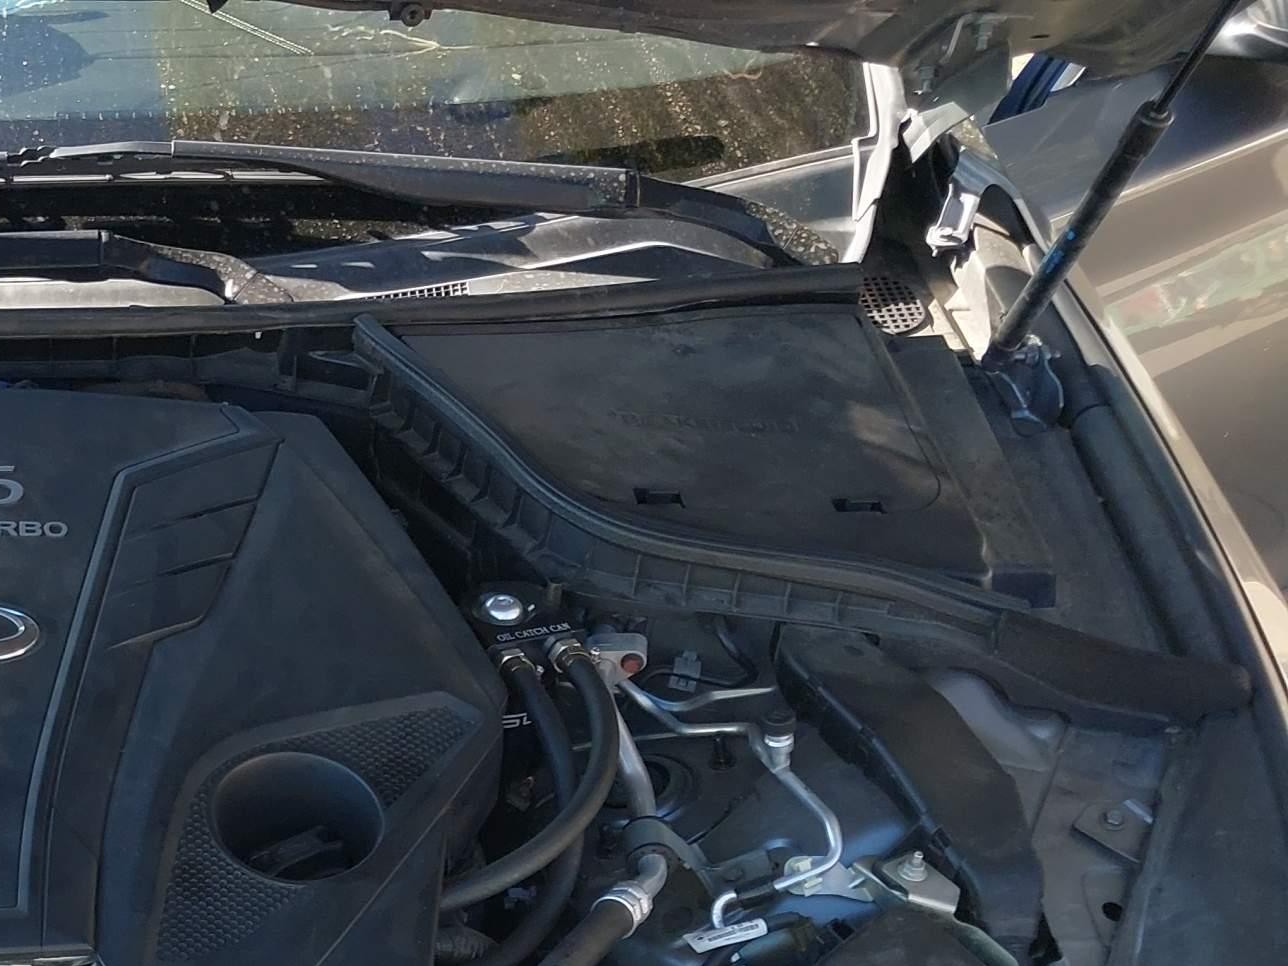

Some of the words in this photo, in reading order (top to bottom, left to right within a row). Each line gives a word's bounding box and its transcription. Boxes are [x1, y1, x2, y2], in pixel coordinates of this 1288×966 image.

[496, 632, 515, 642] OIL
[515, 626, 550, 638] CATCH
[549, 622, 572, 633] CAN
